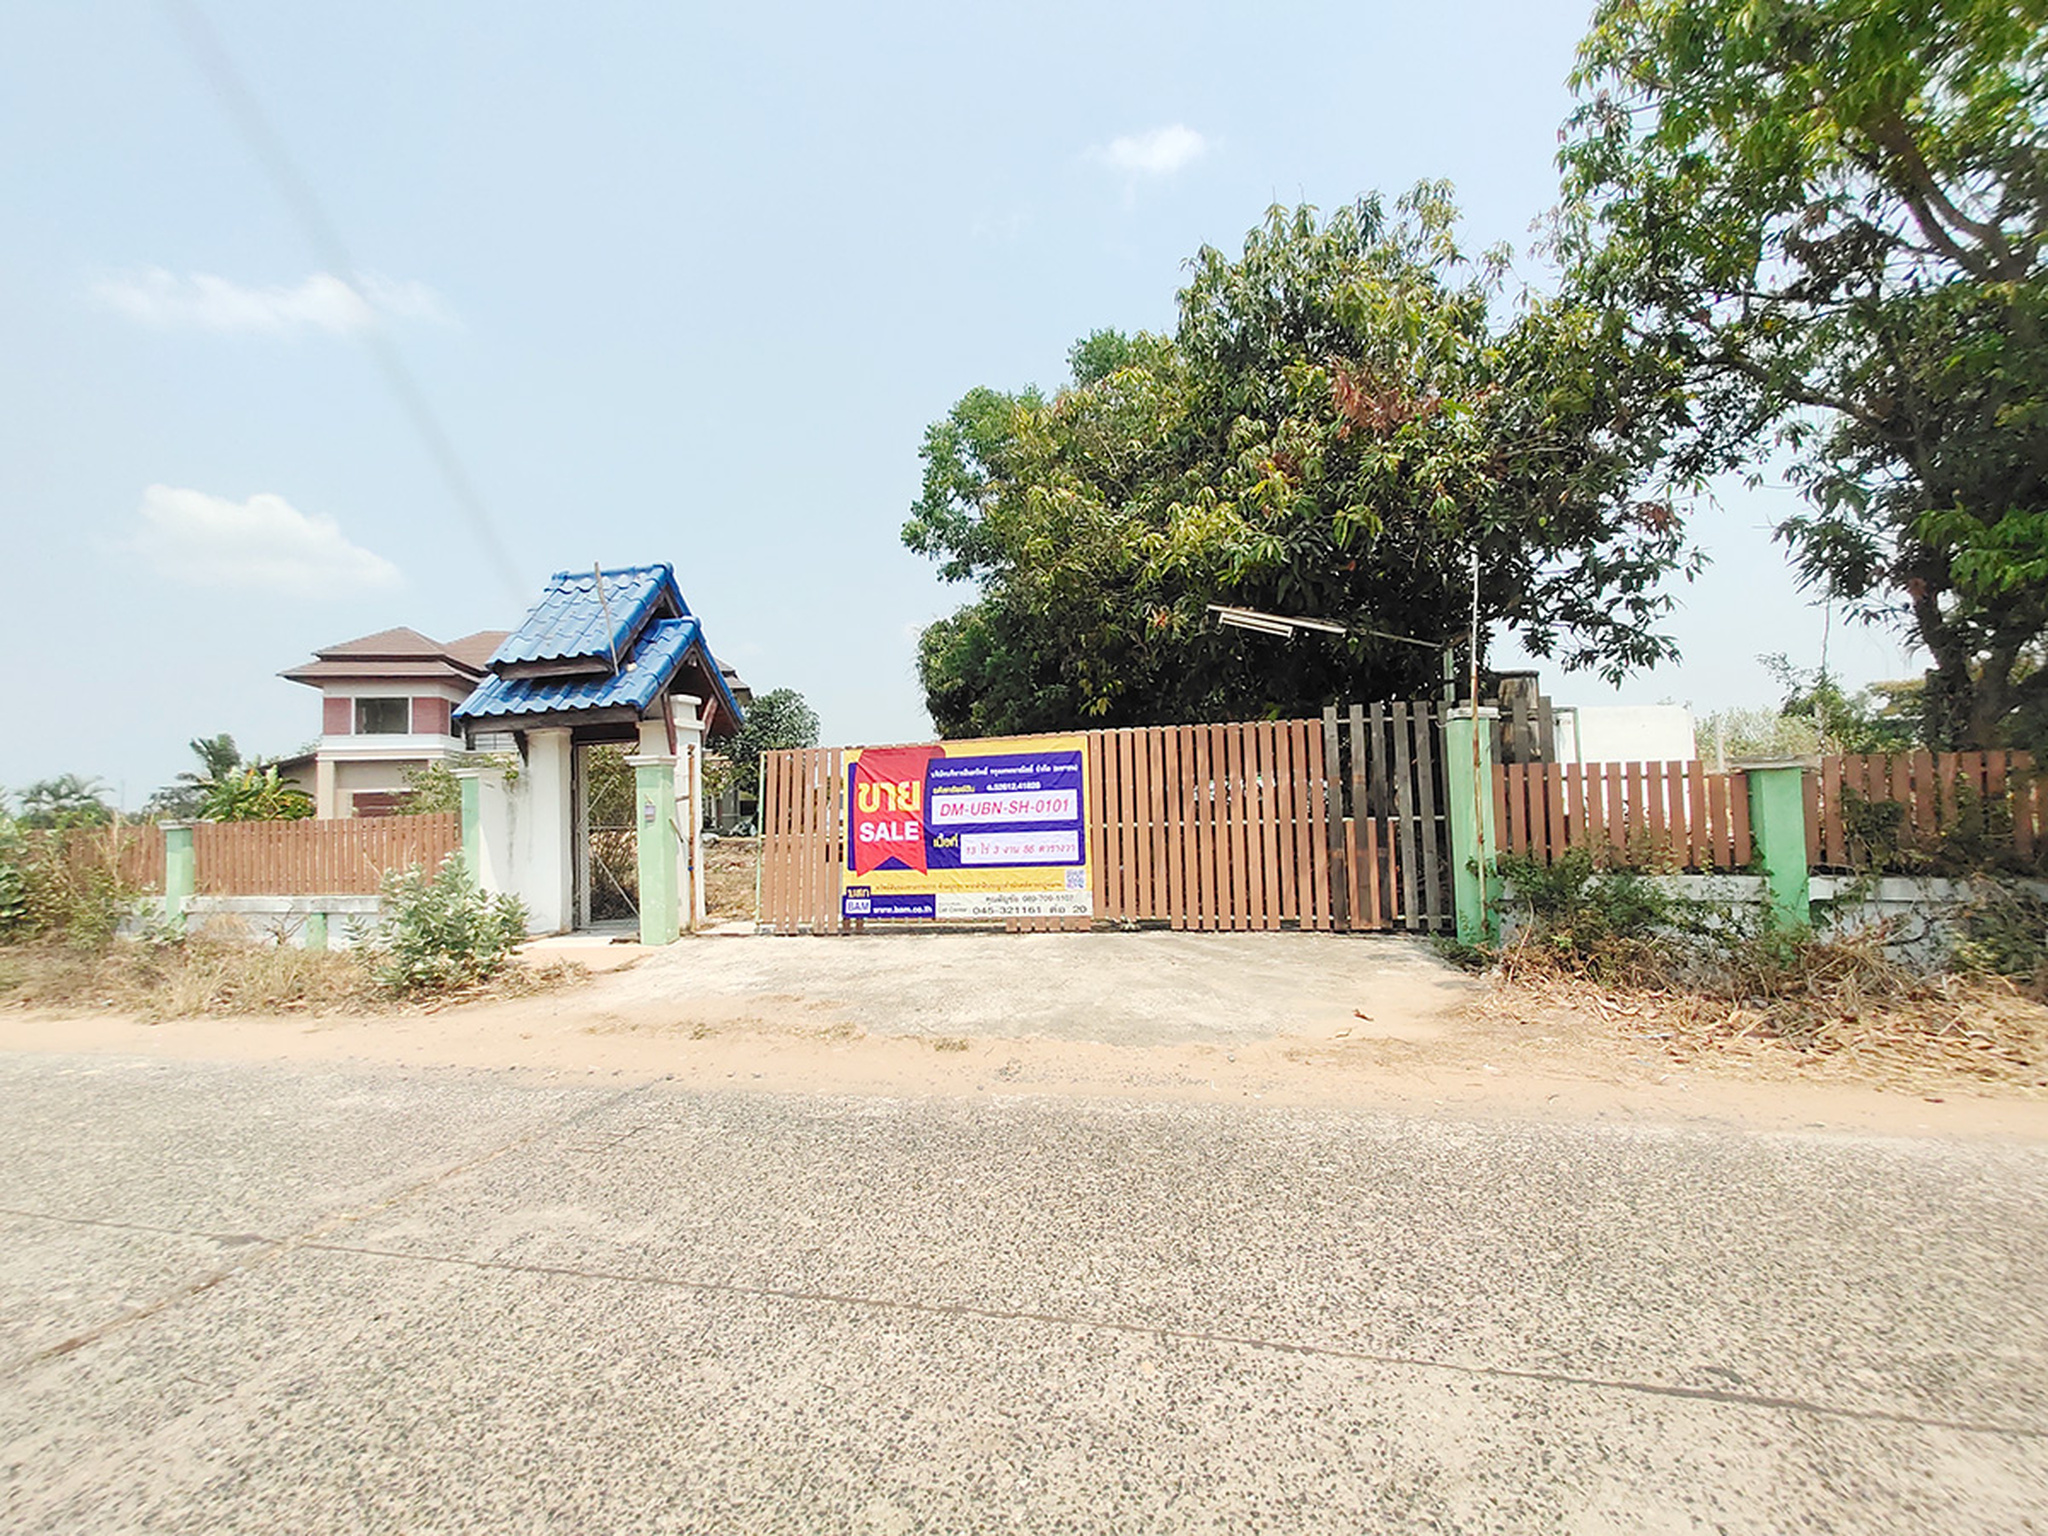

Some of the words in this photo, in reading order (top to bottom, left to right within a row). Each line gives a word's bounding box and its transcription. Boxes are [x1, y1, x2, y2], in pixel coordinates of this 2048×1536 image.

[857, 780, 921, 813] ขาย
[940, 798, 1069, 817] DM-UBN-SH-0101
[859, 821, 920, 843] SALE
[847, 901, 870, 912] BAM
[972, 905, 1042, 915] 045-321161
[1072, 904, 1088, 914] 20
